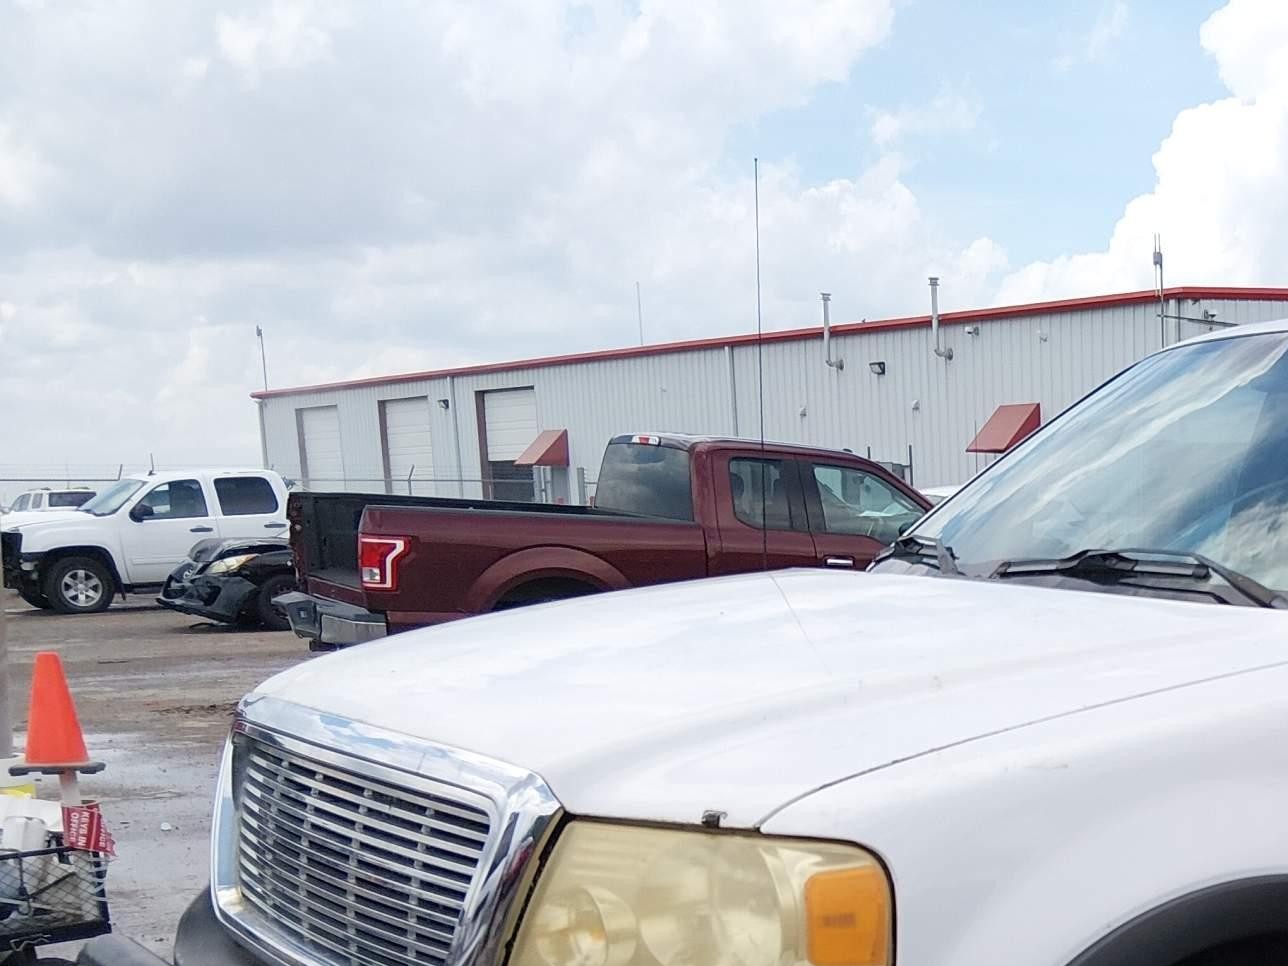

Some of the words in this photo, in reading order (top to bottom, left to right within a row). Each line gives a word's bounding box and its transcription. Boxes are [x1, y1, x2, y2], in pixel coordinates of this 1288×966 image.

[70, 812, 79, 842] OFFICE
[80, 811, 90, 835] KEYS
[78, 836, 87, 847] IN
